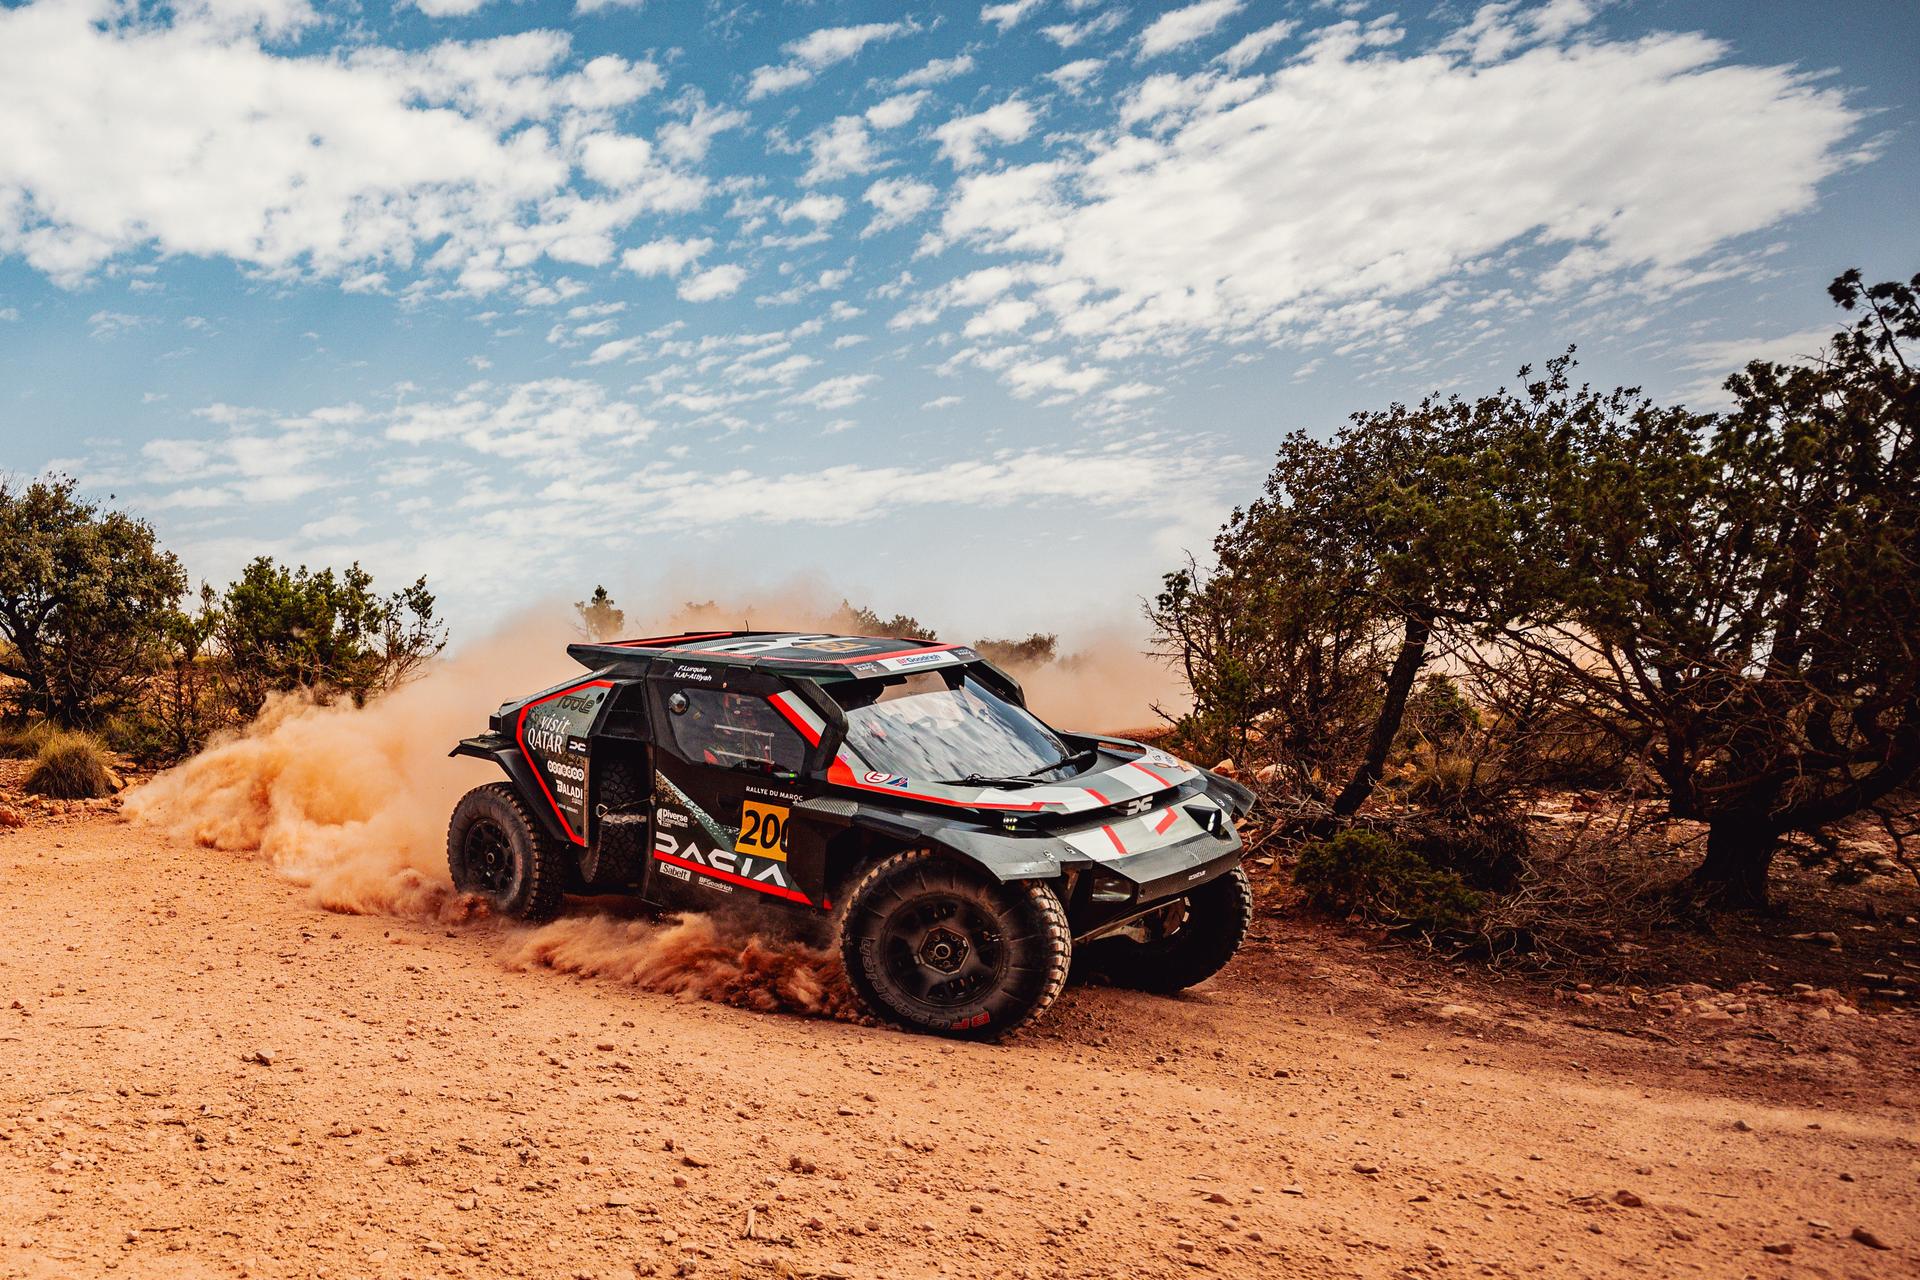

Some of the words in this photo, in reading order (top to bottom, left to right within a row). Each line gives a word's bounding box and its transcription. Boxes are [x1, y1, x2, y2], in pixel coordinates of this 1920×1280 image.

[540, 714, 571, 734] visit
[528, 728, 562, 754] QATAR
[556, 779, 583, 799] BALADI
[746, 786, 768, 795] RALLYE
[769, 788, 779, 797] DU
[779, 791, 804, 802] MAROC
[663, 808, 688, 822] Diverse
[655, 832, 787, 887] DACIA
[663, 864, 687, 880] Sabelt
[698, 876, 733, 892] BFGoodrich
